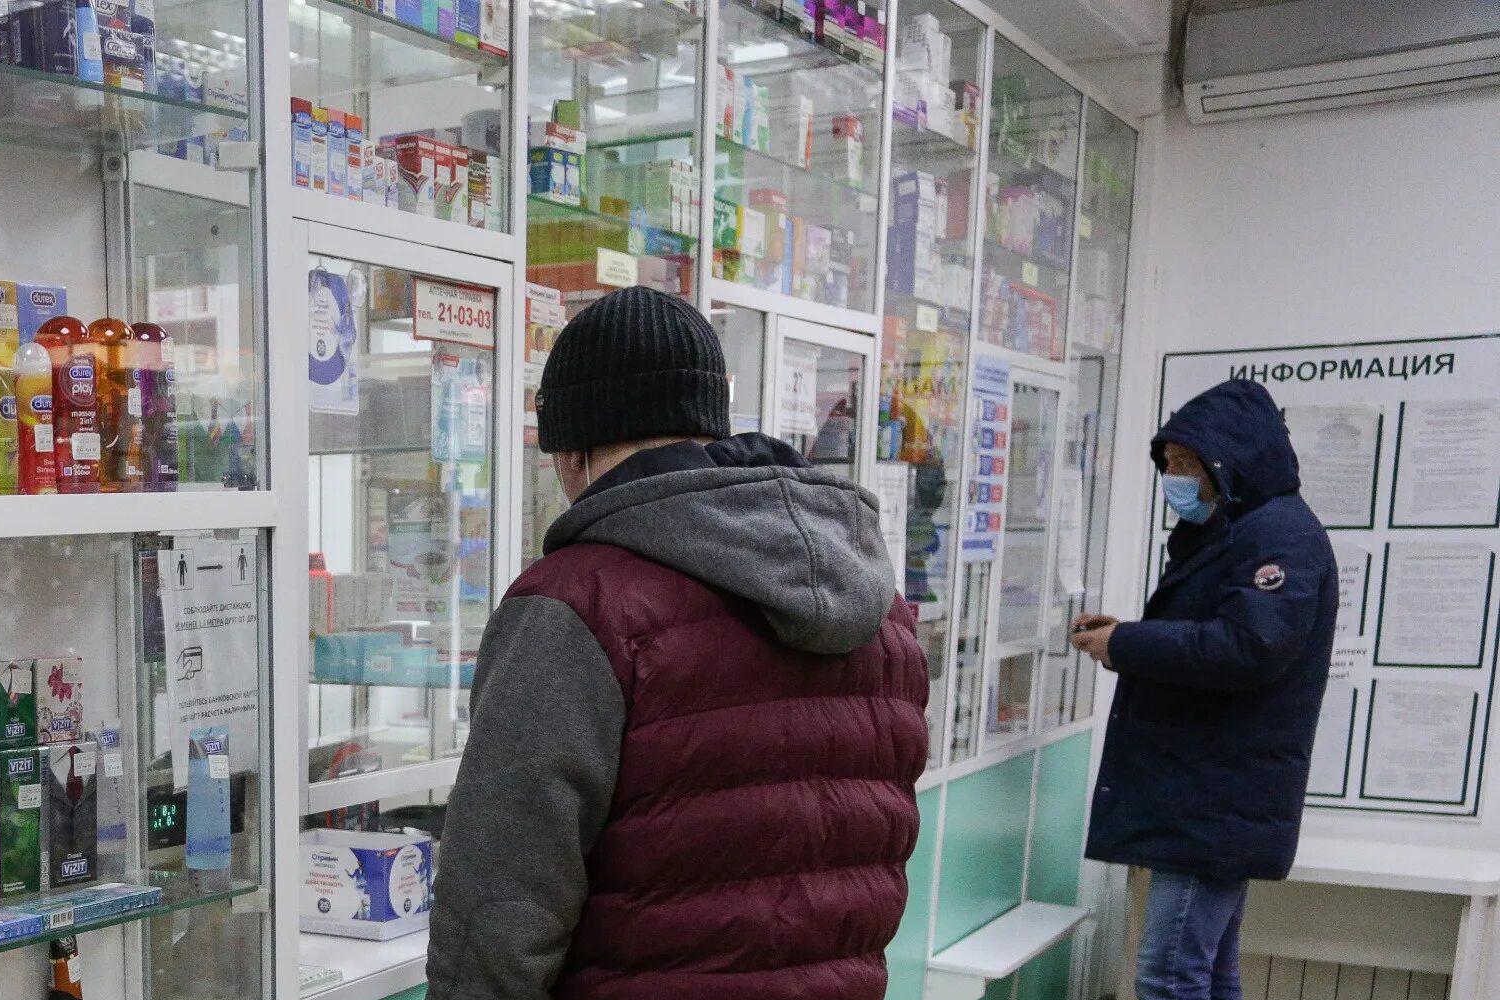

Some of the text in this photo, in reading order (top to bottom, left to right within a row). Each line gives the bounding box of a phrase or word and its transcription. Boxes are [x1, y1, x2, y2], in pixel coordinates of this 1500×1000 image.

[32, 291, 56, 305] durex
[438, 302, 491, 329] 21-03-03
[1229, 353, 1456, 384] ИНФОРМАЦИЯ
[208, 618, 224, 627] МЕТРА
